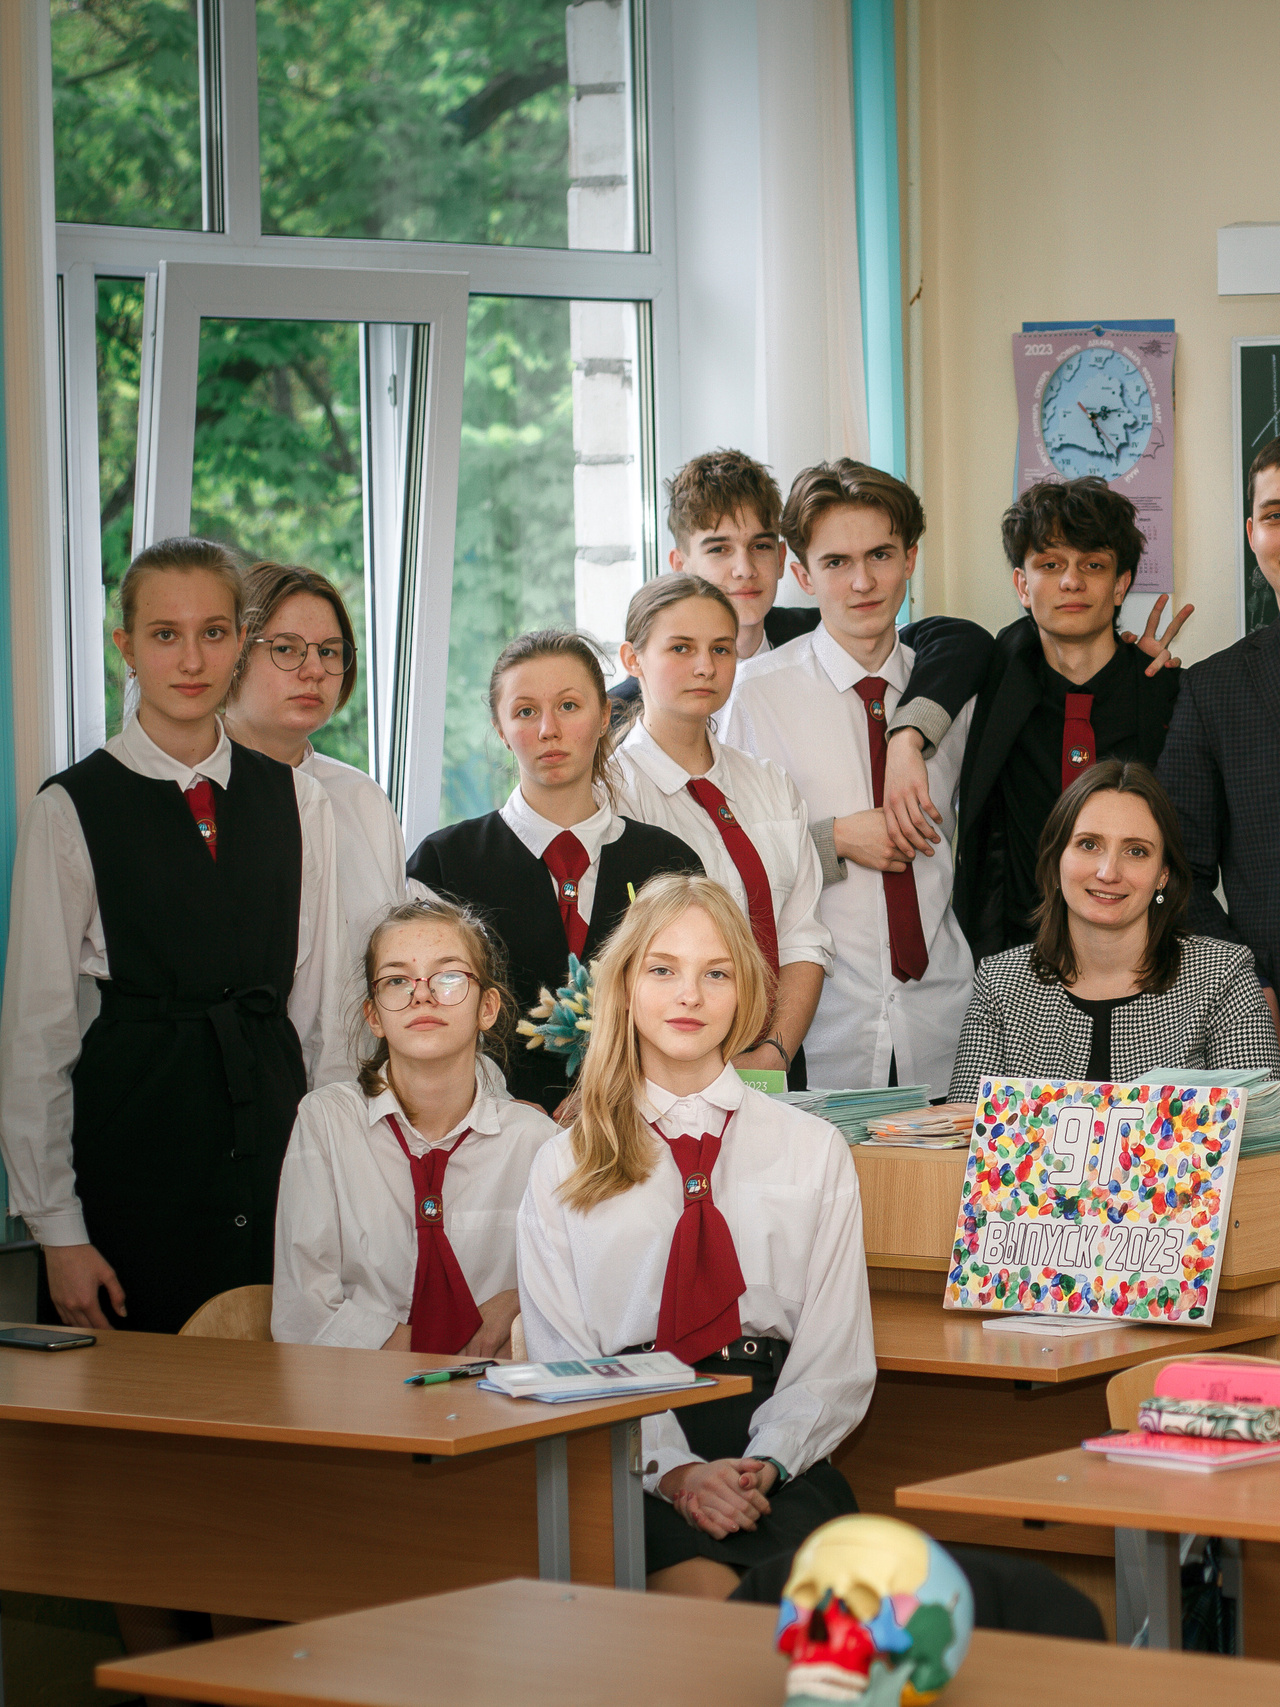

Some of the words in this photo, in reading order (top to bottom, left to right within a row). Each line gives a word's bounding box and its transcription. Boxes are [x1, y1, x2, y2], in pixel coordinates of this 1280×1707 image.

[1024, 343, 1053, 356] 2023
[1047, 1106, 1145, 1186] 9Г
[982, 1221, 1099, 1269] ВЫПУСК
[1104, 1226, 1184, 1274] 2023
